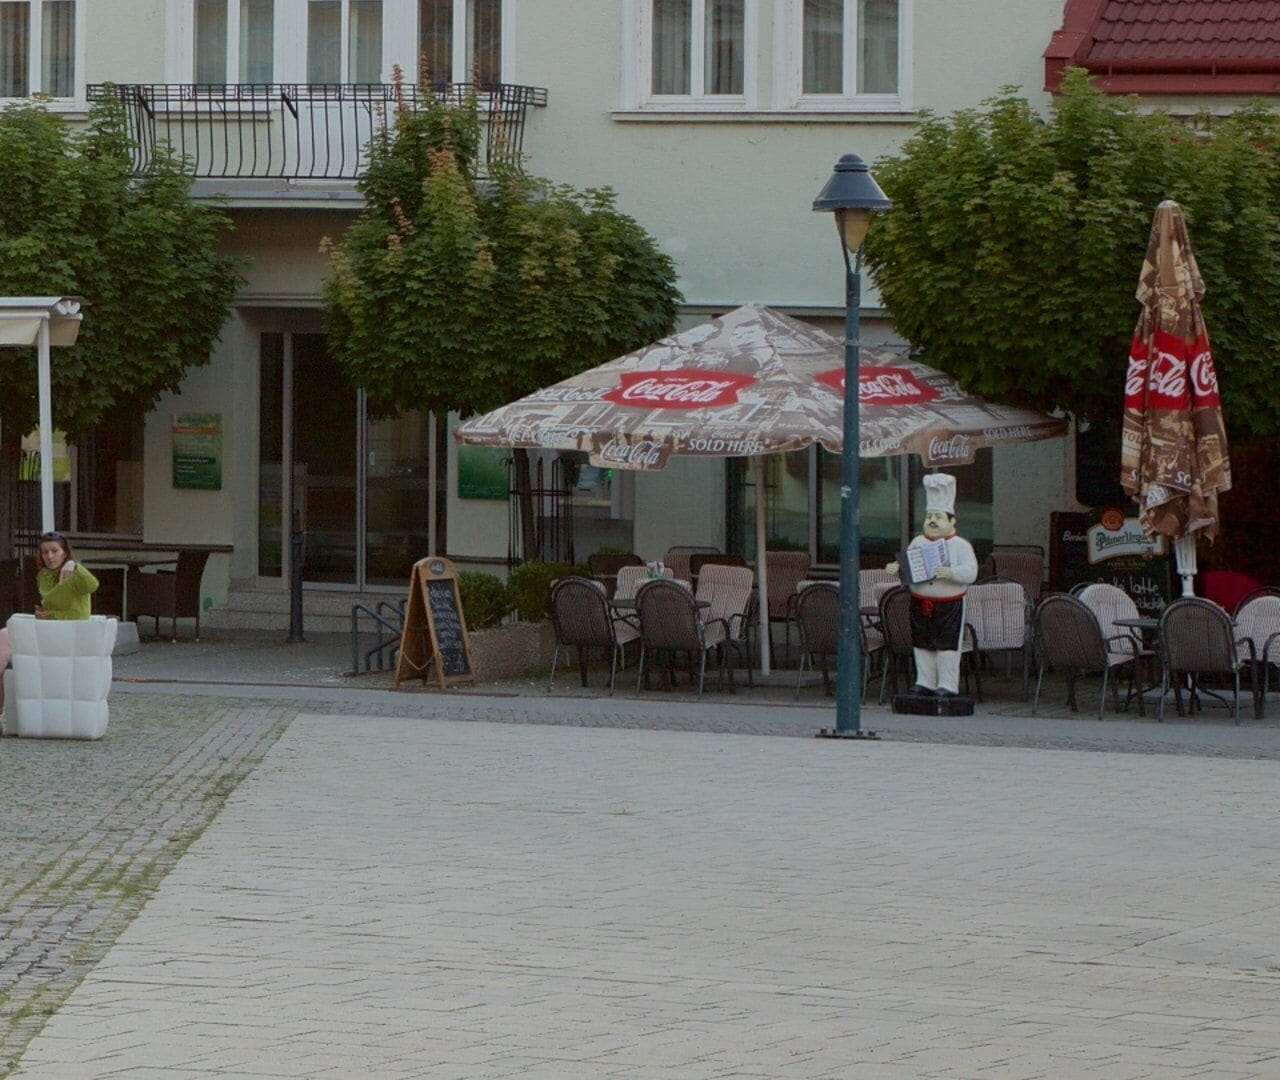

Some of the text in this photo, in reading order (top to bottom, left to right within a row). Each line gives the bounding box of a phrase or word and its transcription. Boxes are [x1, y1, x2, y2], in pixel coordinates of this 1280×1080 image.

[622, 378, 736, 403] Coca-Cola
[599, 439, 662, 465] Coca-Cola
[689, 439, 763, 455] SOLD HERE
[928, 434, 970, 461] Coca-Cola
